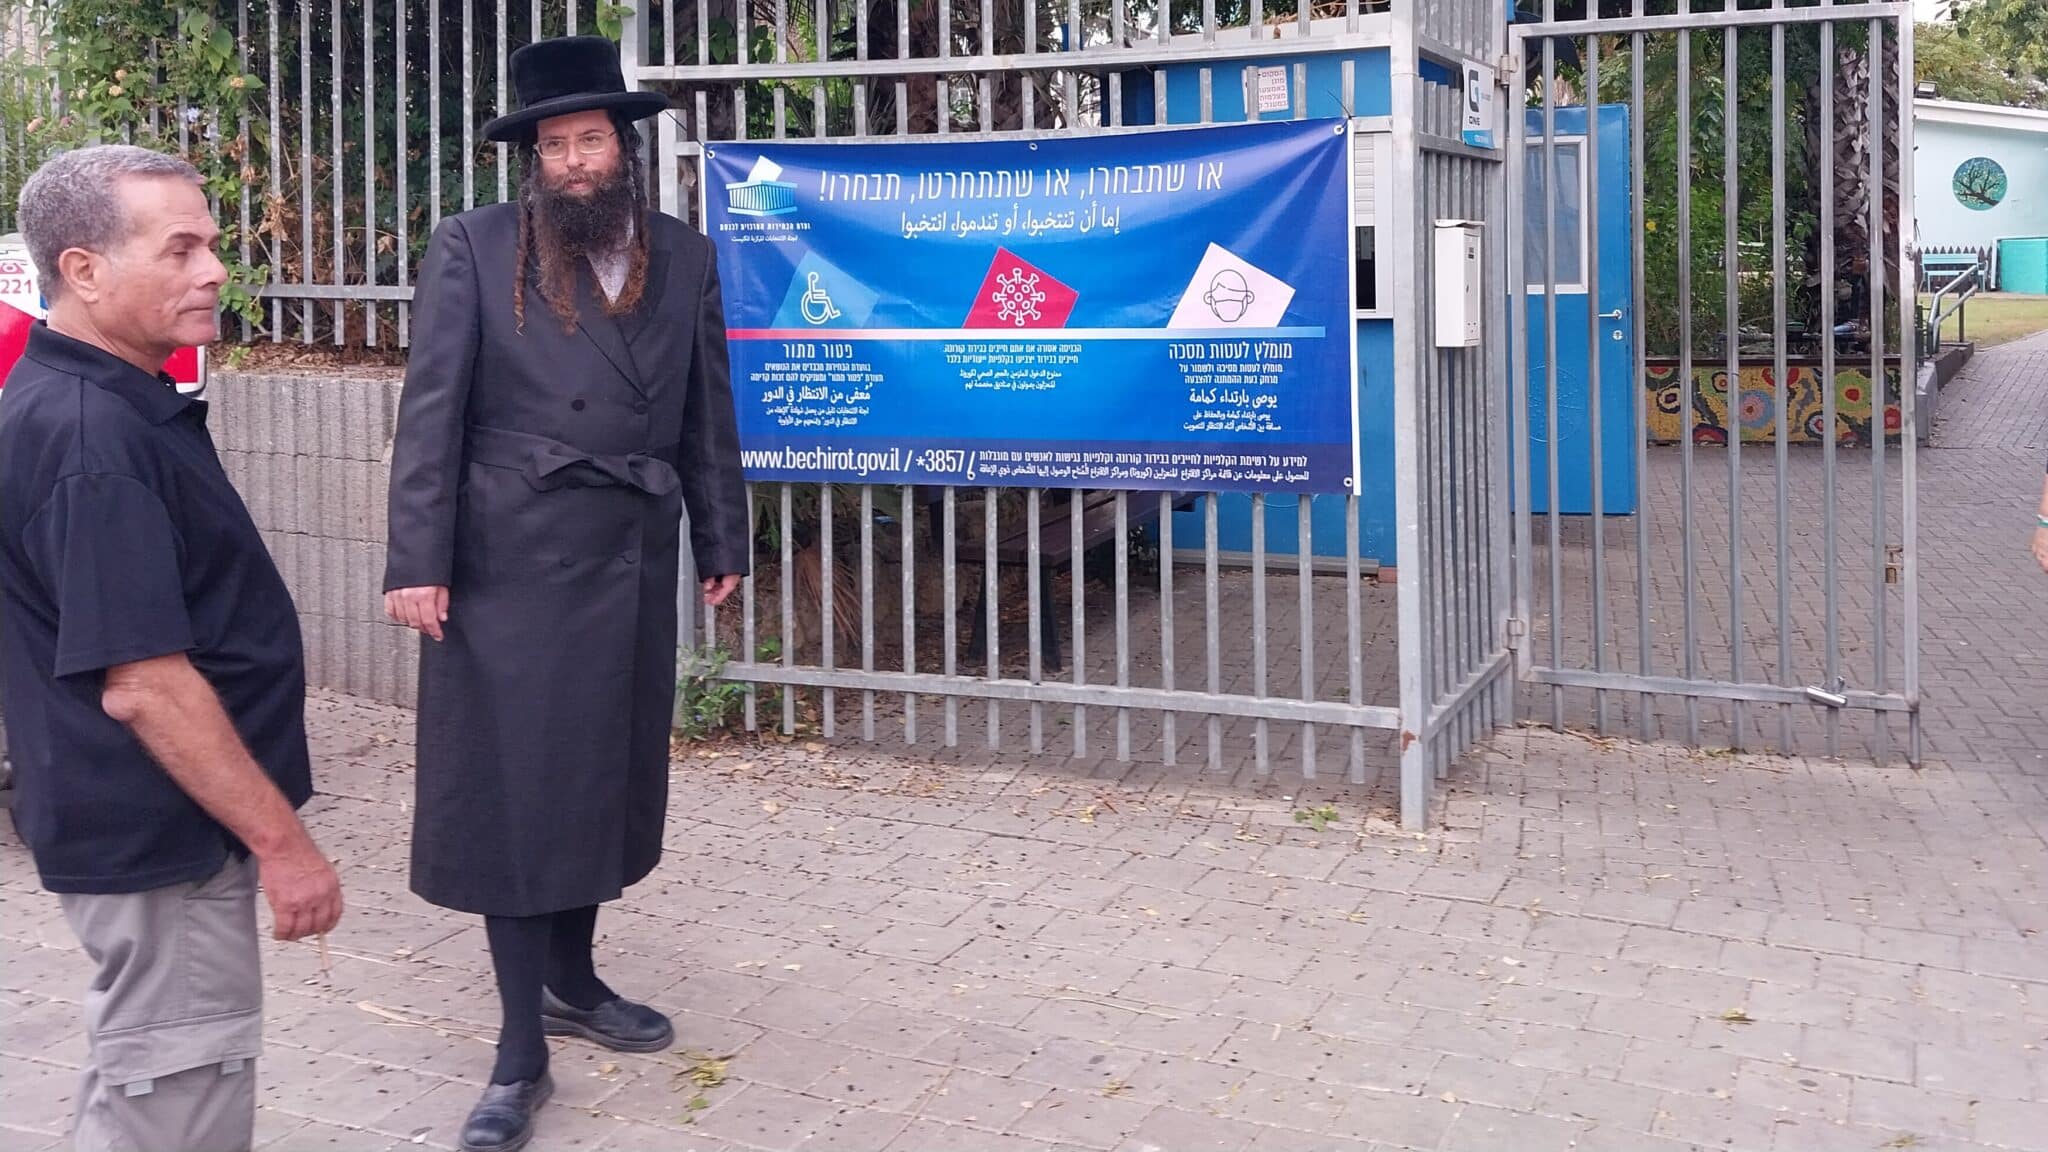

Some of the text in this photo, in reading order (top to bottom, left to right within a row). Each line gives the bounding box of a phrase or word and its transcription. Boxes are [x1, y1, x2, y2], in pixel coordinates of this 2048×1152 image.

[819, 162, 1224, 204] או שתבחרו, או שתתחרטו, תבחרו!
[901, 202, 1121, 241] إما أن تنتخبوا، أو تندموا، انتخبوا
[783, 343, 853, 358] פטור מתור
[1026, 344, 1035, 352] אם
[1037, 344, 1056, 352] אסורה
[1059, 344, 1081, 352] הכניסה
[1169, 341, 1292, 361] מומלץ לעטות מסכה
[1059, 355, 1078, 363] חייבים
[791, 363, 801, 371] את
[1179, 363, 1188, 372] על
[1239, 363, 1260, 372] לעטות
[1262, 364, 1283, 373] מומלץ
[1184, 374, 1213, 384] להצבעה
[1244, 375, 1258, 384] בעת
[1259, 375, 1278, 385] מרחק
[761, 386, 784, 402] الدور
[786, 386, 794, 405] في
[797, 386, 828, 402] الانتظار
[830, 390, 843, 403] من
[1189, 387, 1217, 404] كمامة
[1219, 388, 1249, 407] بارتداء
[741, 446, 900, 476] www.bechirot.gov.il
[904, 450, 913, 472] /
[980, 450, 1307, 467] למידע על רשימת הקלפיות לחייבים בבידוד קורונה וקלפיות נגישות לאנשים עם מוגבלות
